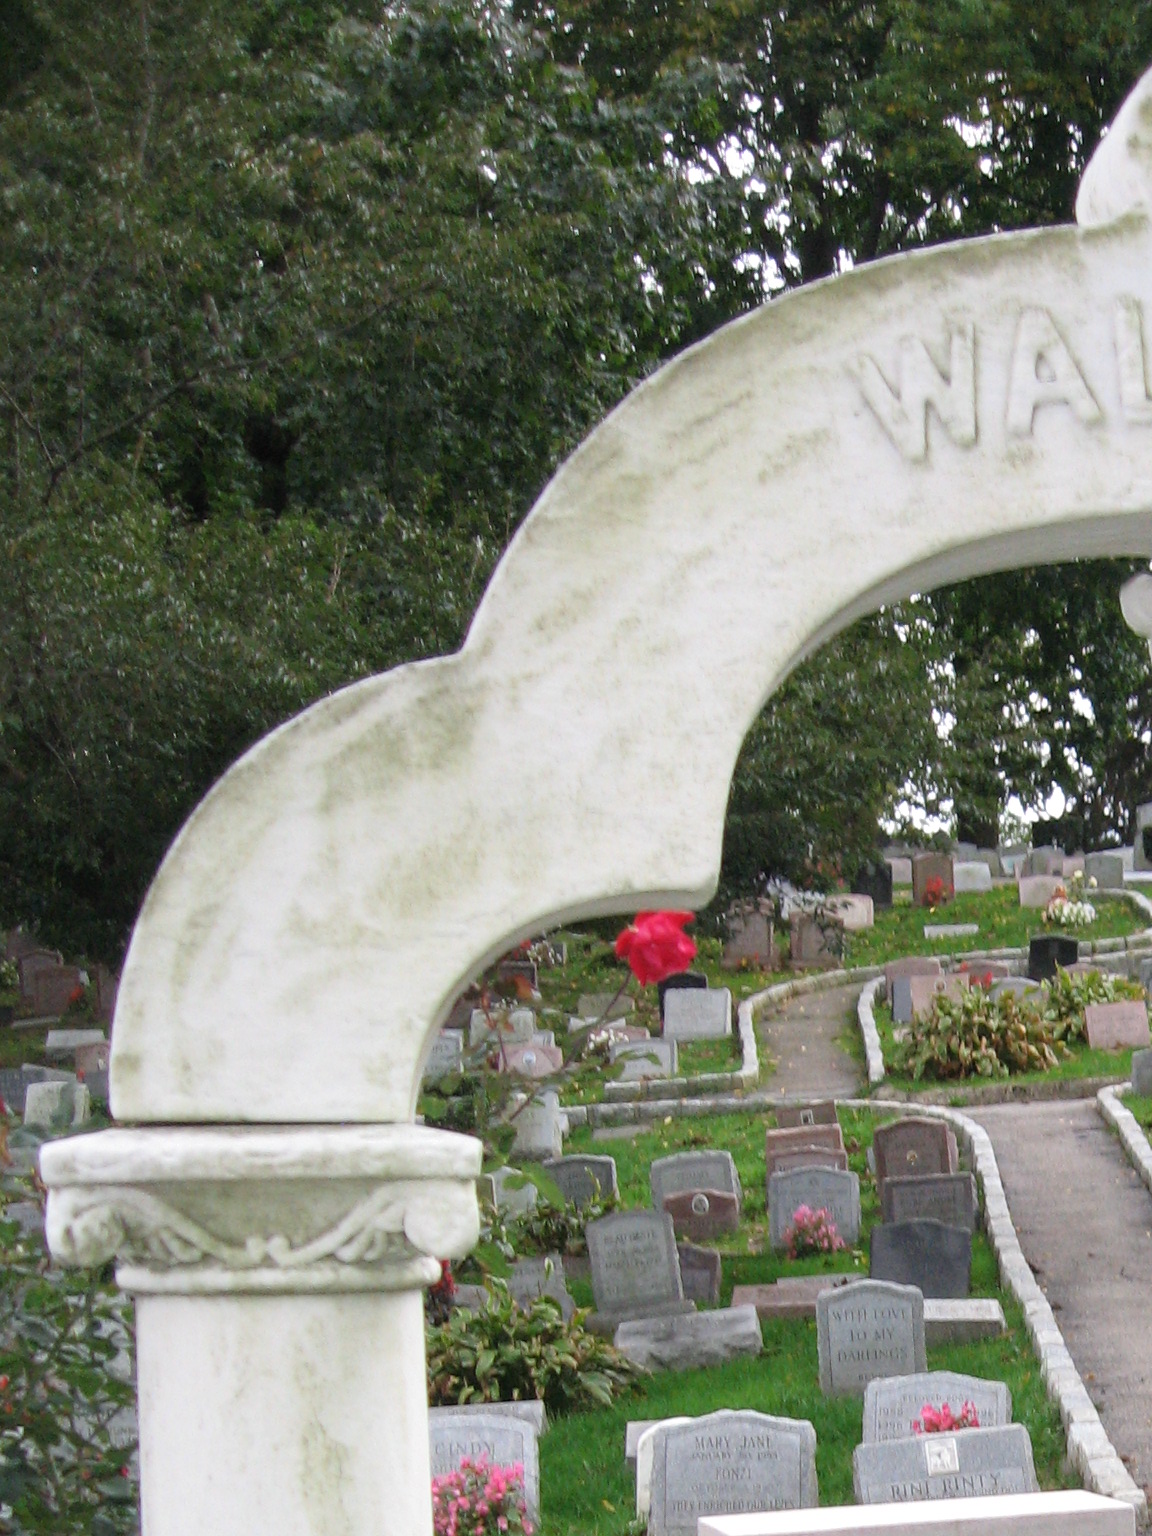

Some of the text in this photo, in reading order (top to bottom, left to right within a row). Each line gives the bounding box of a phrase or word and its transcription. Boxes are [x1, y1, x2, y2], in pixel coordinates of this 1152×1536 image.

[832, 1306, 906, 1324] WITH LOVE
[849, 1327, 895, 1343] TO MY
[837, 1347, 910, 1363] DARLINGS
[694, 1434, 772, 1450] MARY JANE
[942, 1472, 1001, 1493] RINTY
